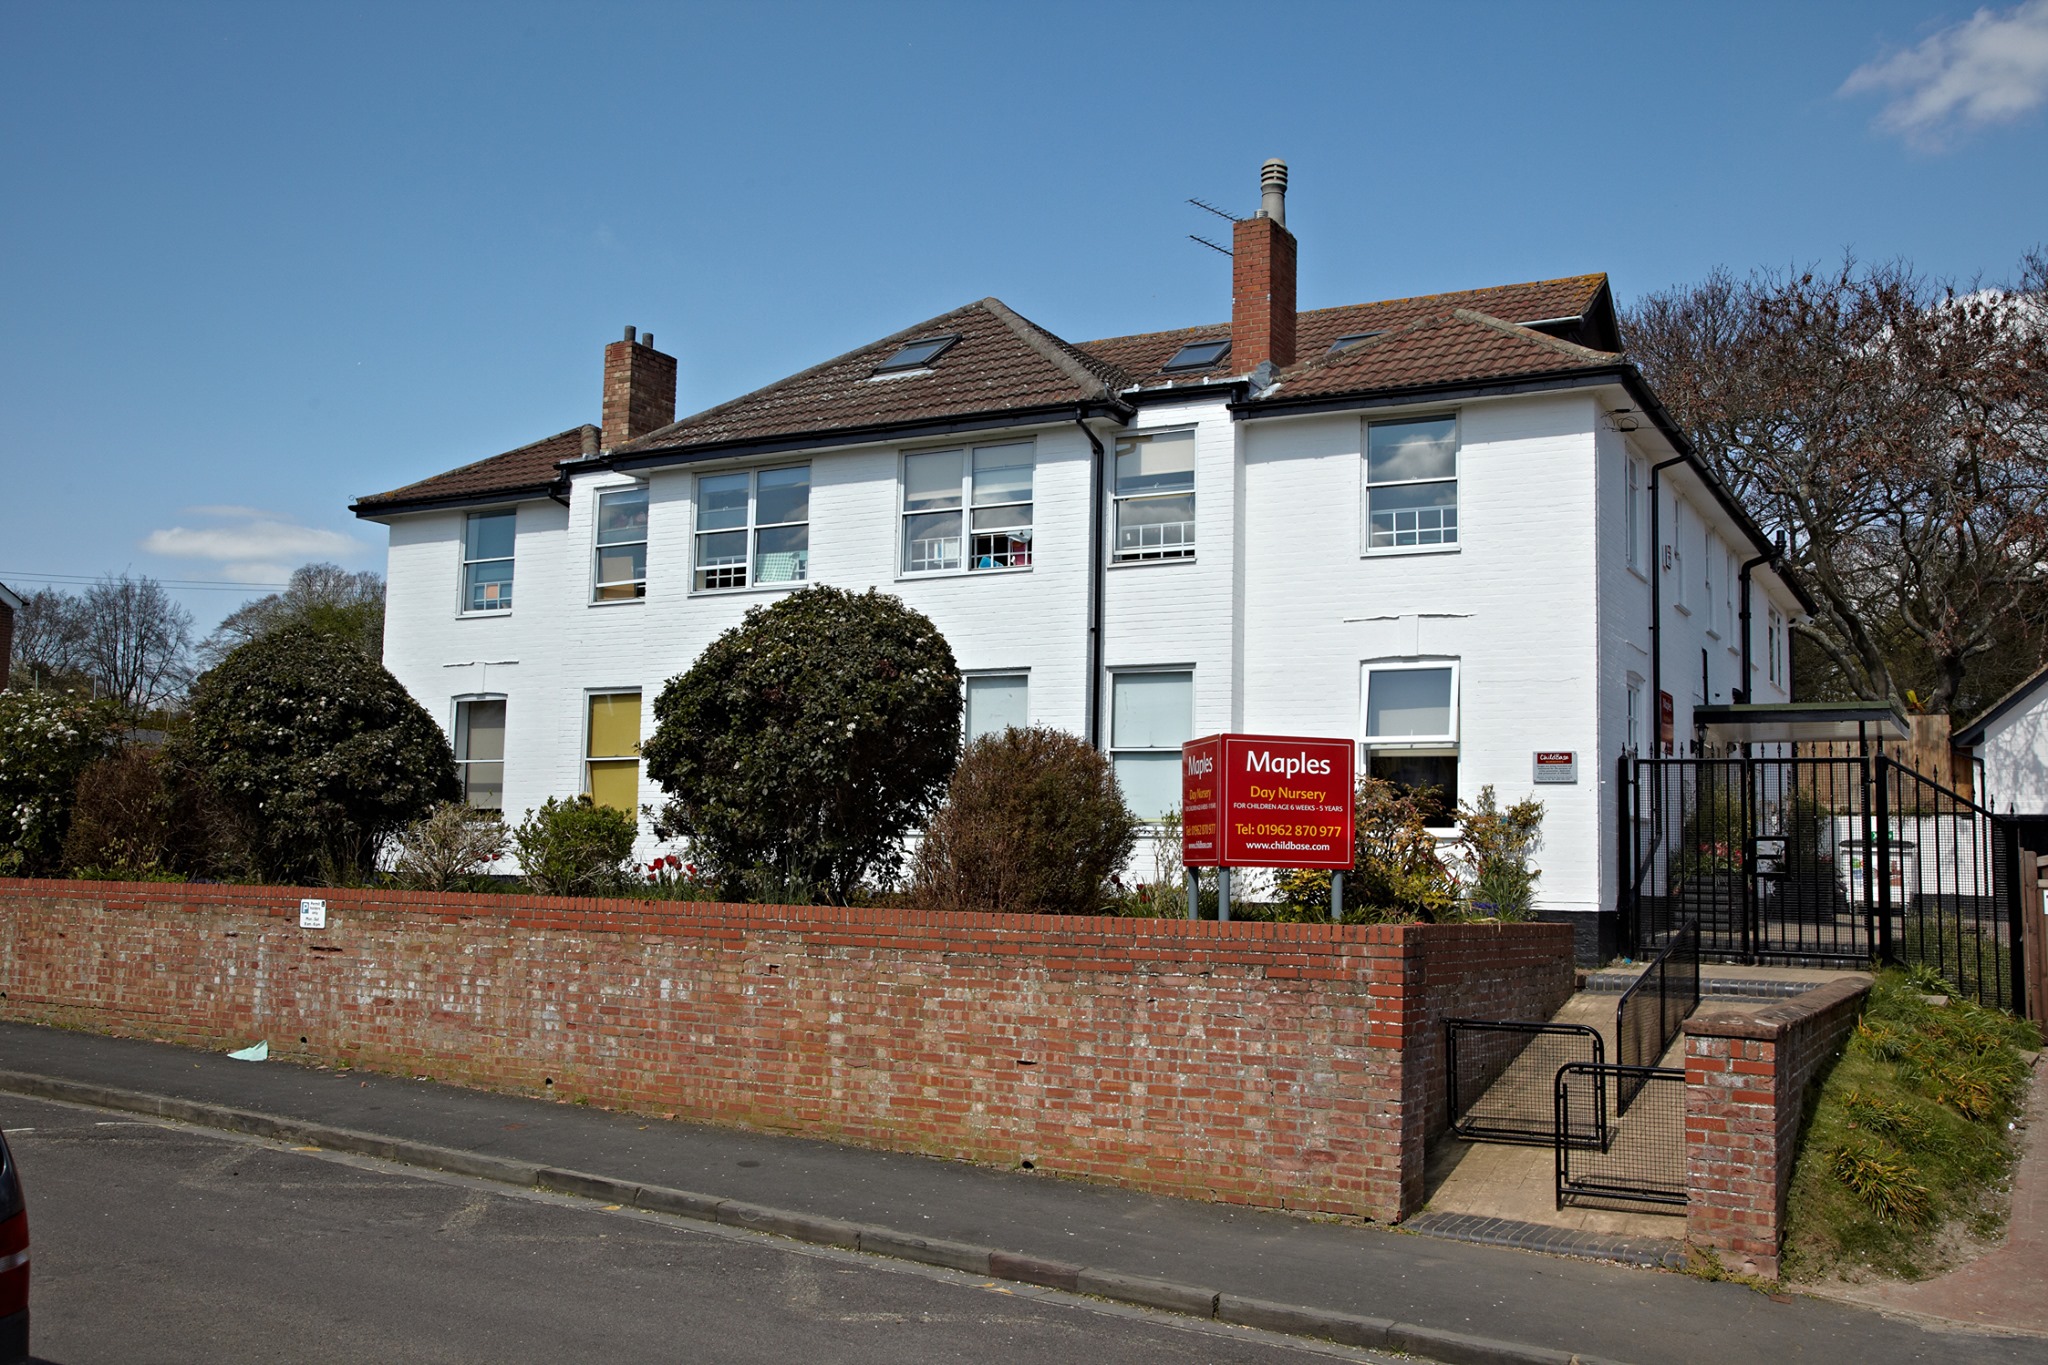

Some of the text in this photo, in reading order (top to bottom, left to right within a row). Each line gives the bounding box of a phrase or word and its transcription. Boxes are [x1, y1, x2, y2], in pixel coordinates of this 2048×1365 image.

[1188, 751, 1213, 780] Maples
[1246, 750, 1331, 779] Maples
[1189, 787, 1211, 802] Day Nursery
[1250, 785, 1327, 803] Day Nursery
[1246, 802, 1277, 810] CHILDREN
[1277, 803, 1290, 811] AGE
[1235, 823, 1342, 838] Tel: 01962 870 977
[1245, 840, 1330, 851] www.childbase.com
